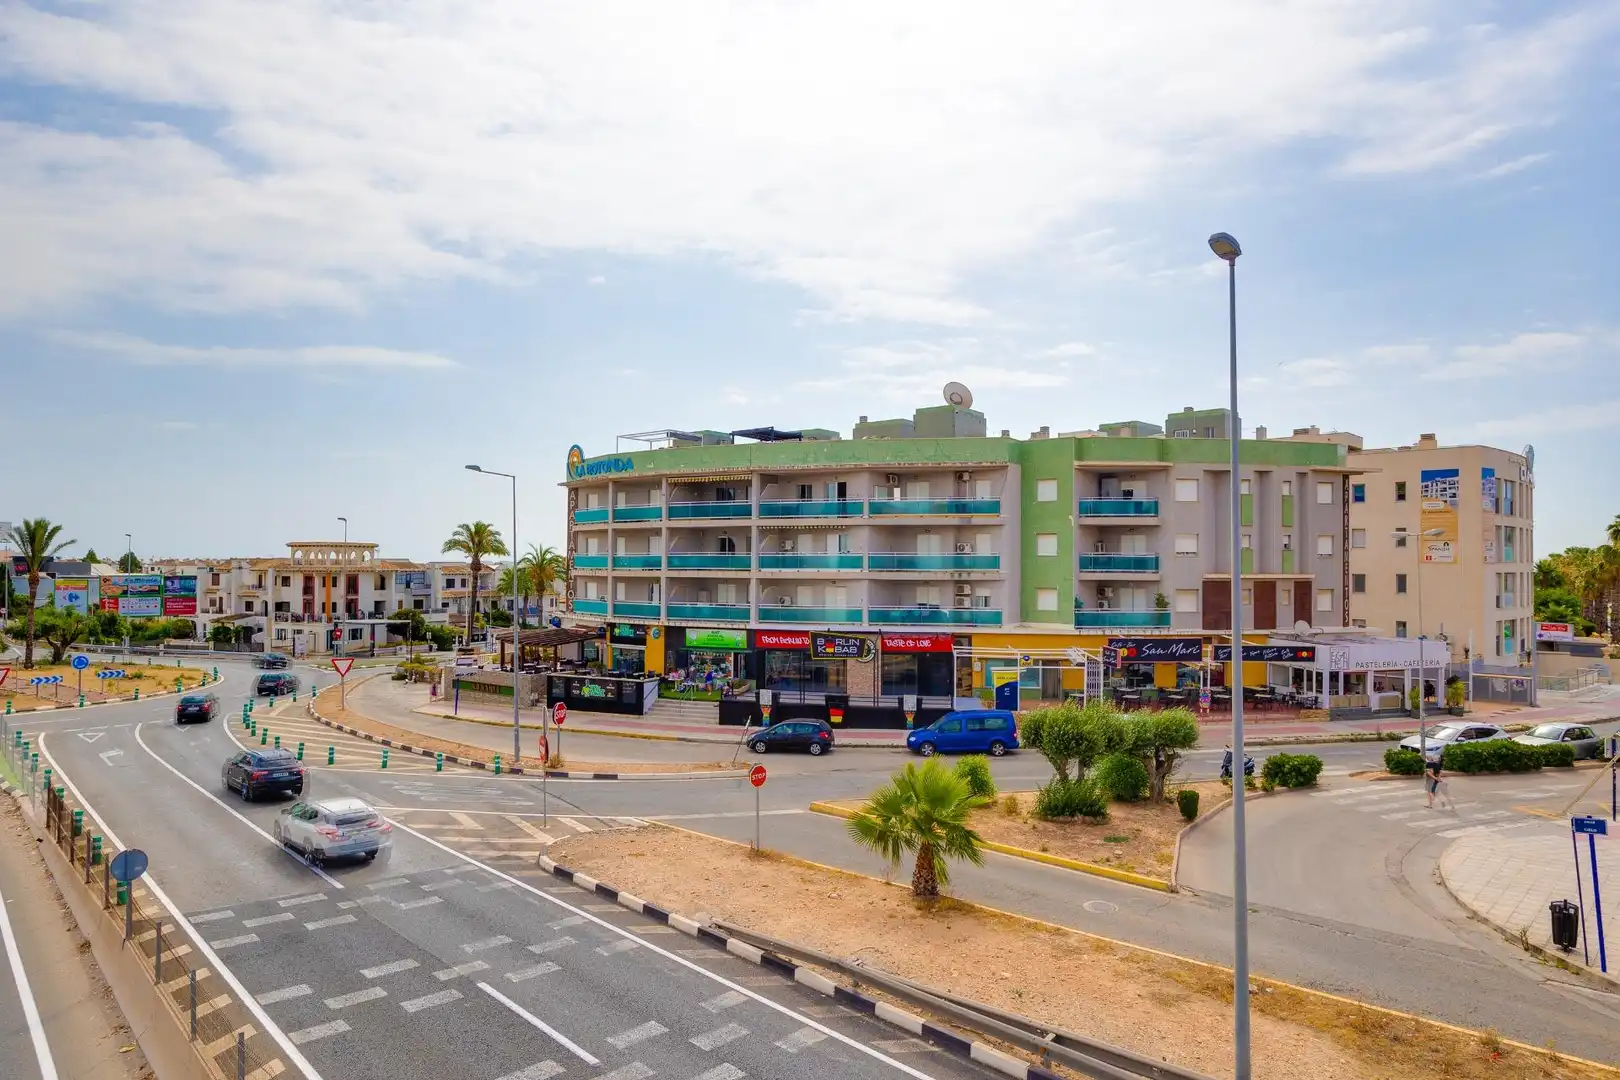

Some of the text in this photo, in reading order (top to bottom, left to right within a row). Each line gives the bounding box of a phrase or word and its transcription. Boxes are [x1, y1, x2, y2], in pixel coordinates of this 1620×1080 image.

[575, 457, 635, 478] LA ROTONDA
[761, 635, 780, 645] FROM
[816, 638, 860, 647] BRLIN
[817, 645, 858, 655] KBAB
[1355, 660, 1398, 669] PASTELERÍA
